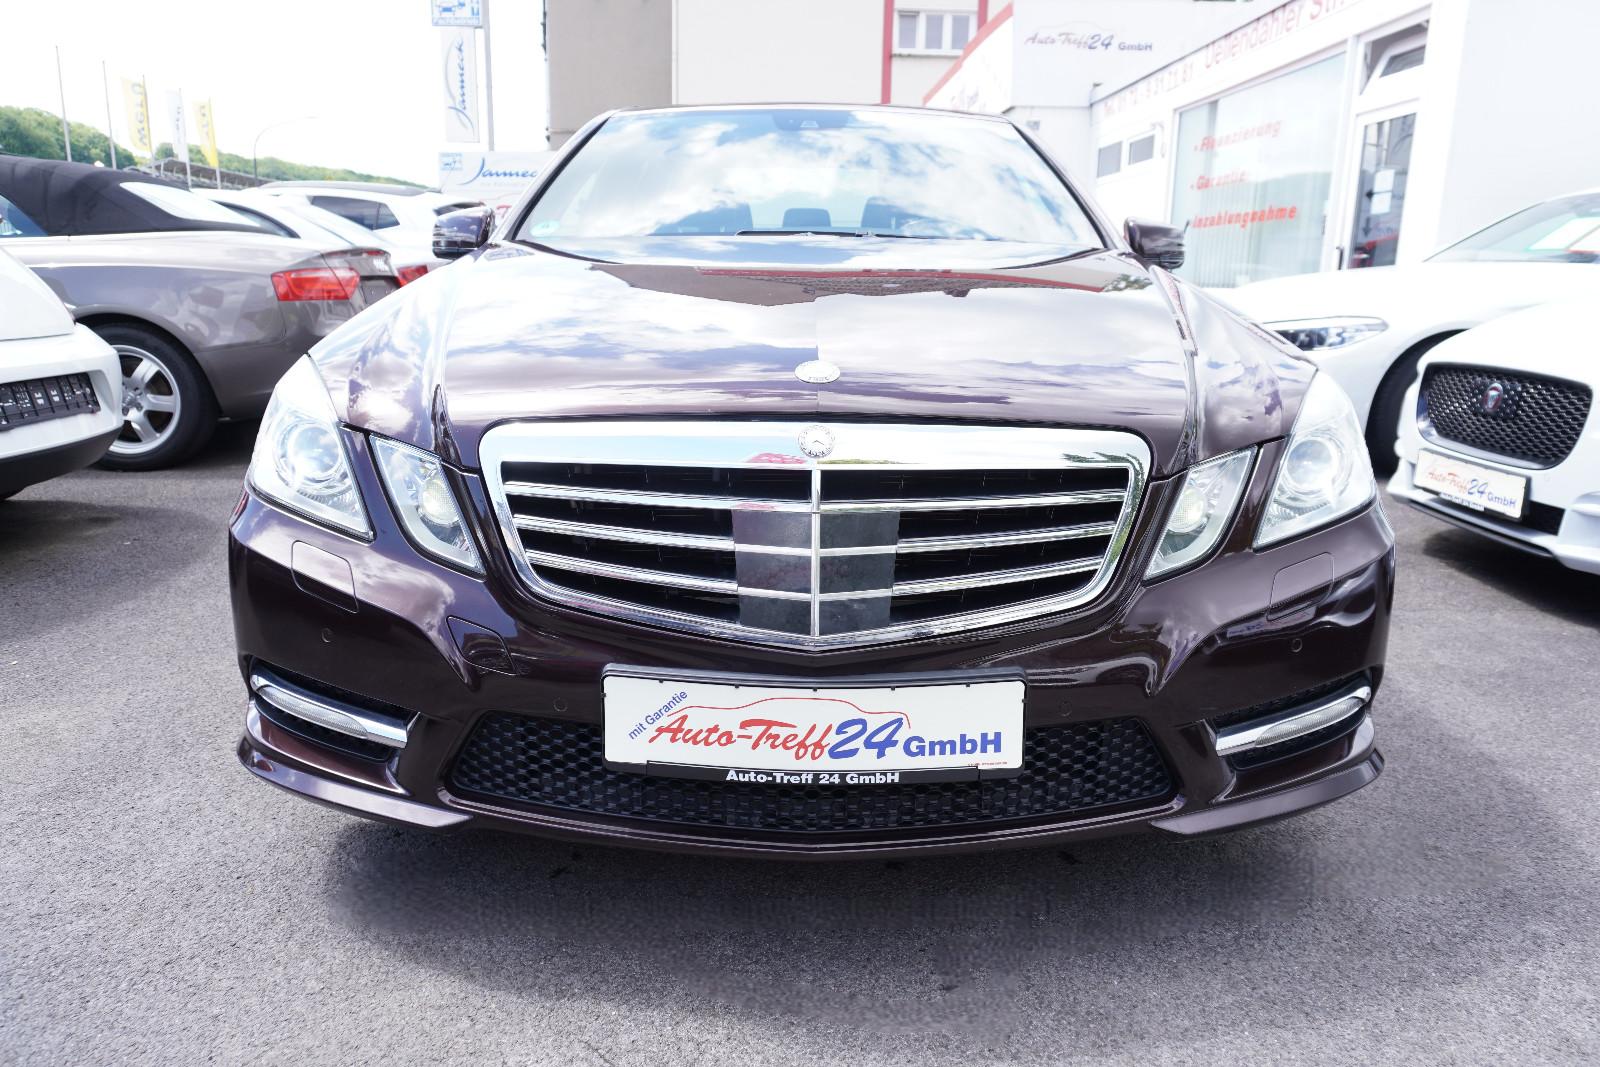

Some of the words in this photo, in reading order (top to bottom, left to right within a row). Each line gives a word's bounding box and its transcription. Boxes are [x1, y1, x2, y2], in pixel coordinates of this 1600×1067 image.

[1118, 42, 1153, 52] GmbH
[1487, 491, 1517, 508] GmbH
[627, 722, 647, 741] mit
[645, 690, 688, 726] Garantie
[902, 731, 1003, 758] GmbH
[725, 769, 814, 784] Auto-Treff
[818, 773, 841, 785] 24
[845, 772, 900, 785] GmbH
